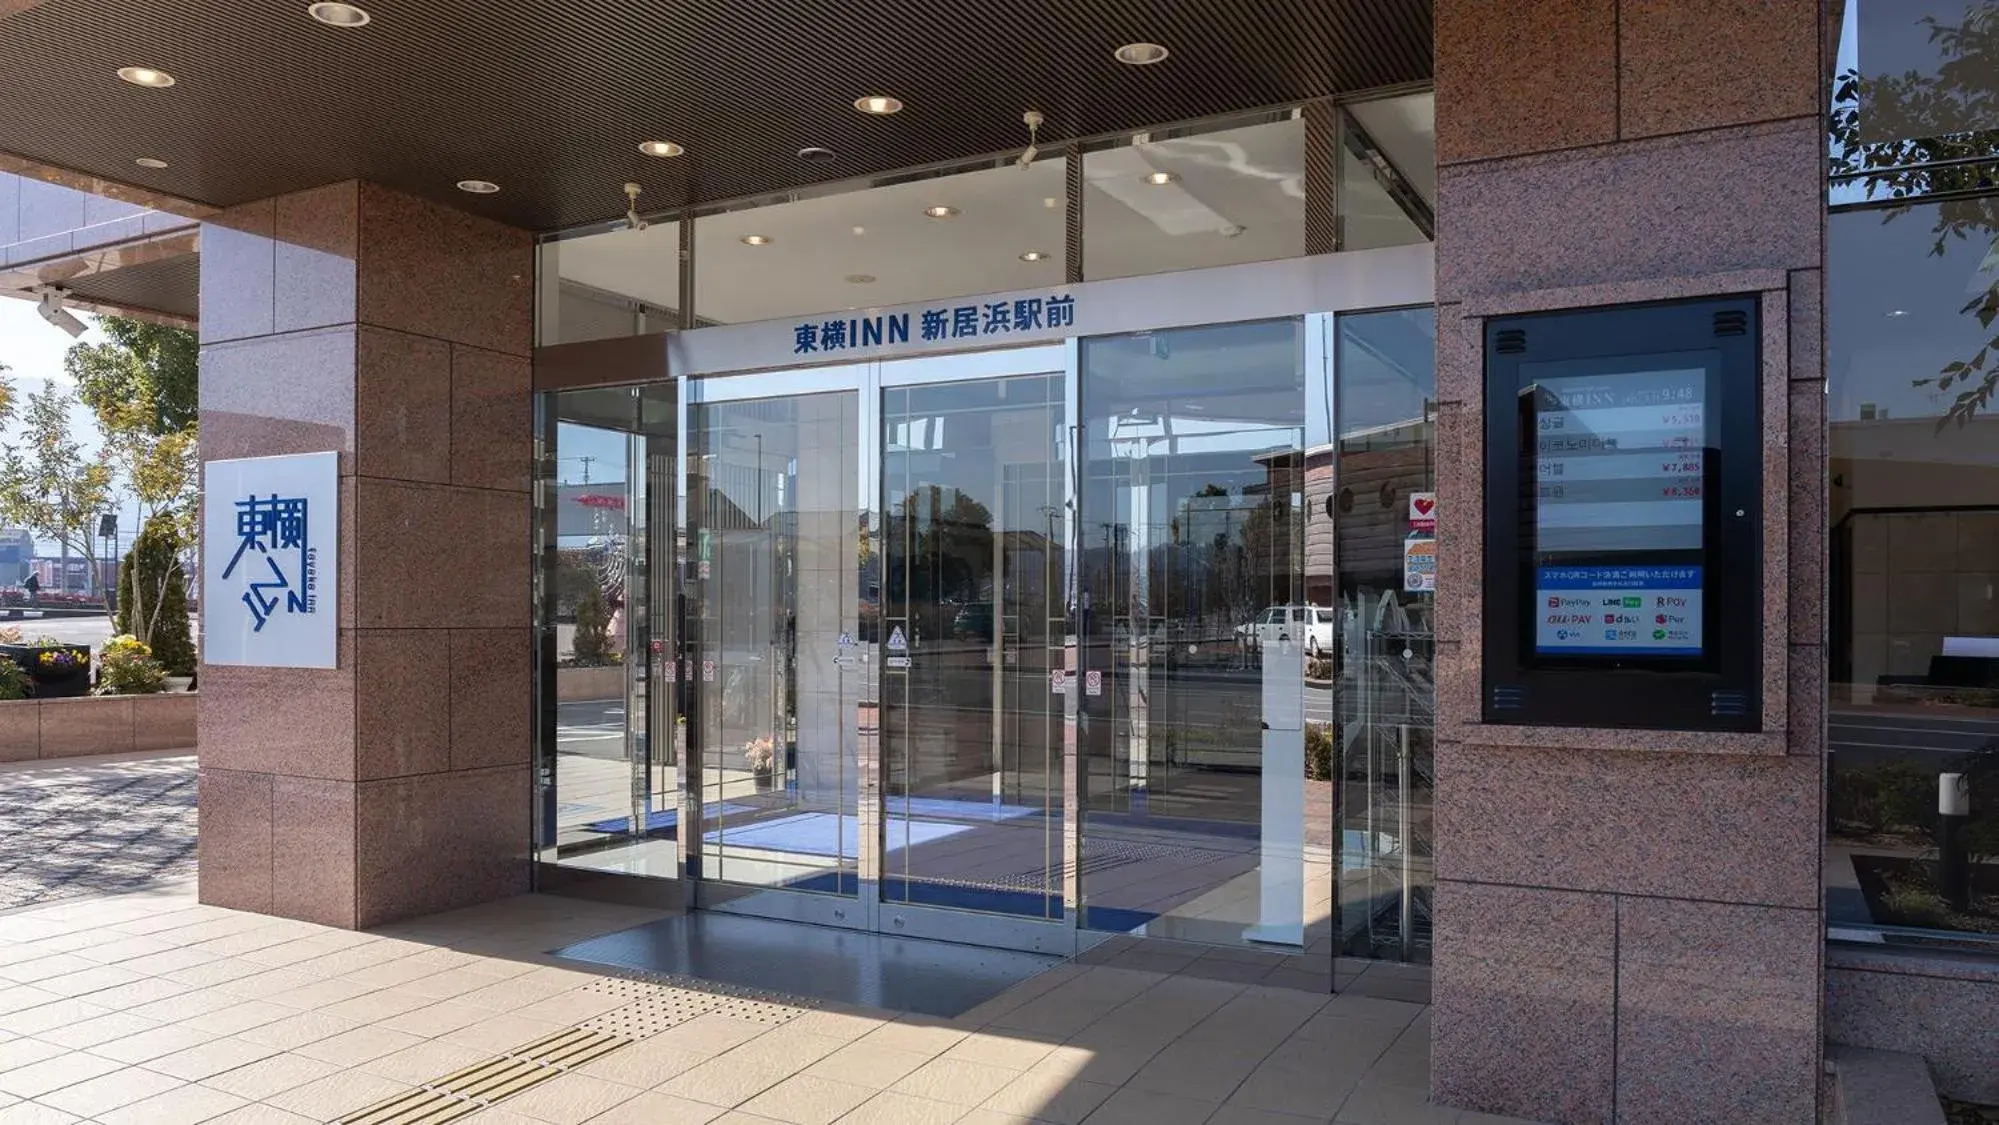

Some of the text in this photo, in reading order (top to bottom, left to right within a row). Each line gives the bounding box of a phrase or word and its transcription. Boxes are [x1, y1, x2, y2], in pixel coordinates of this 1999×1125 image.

[794, 294, 1075, 354] 東横INN 新居浜駅前
